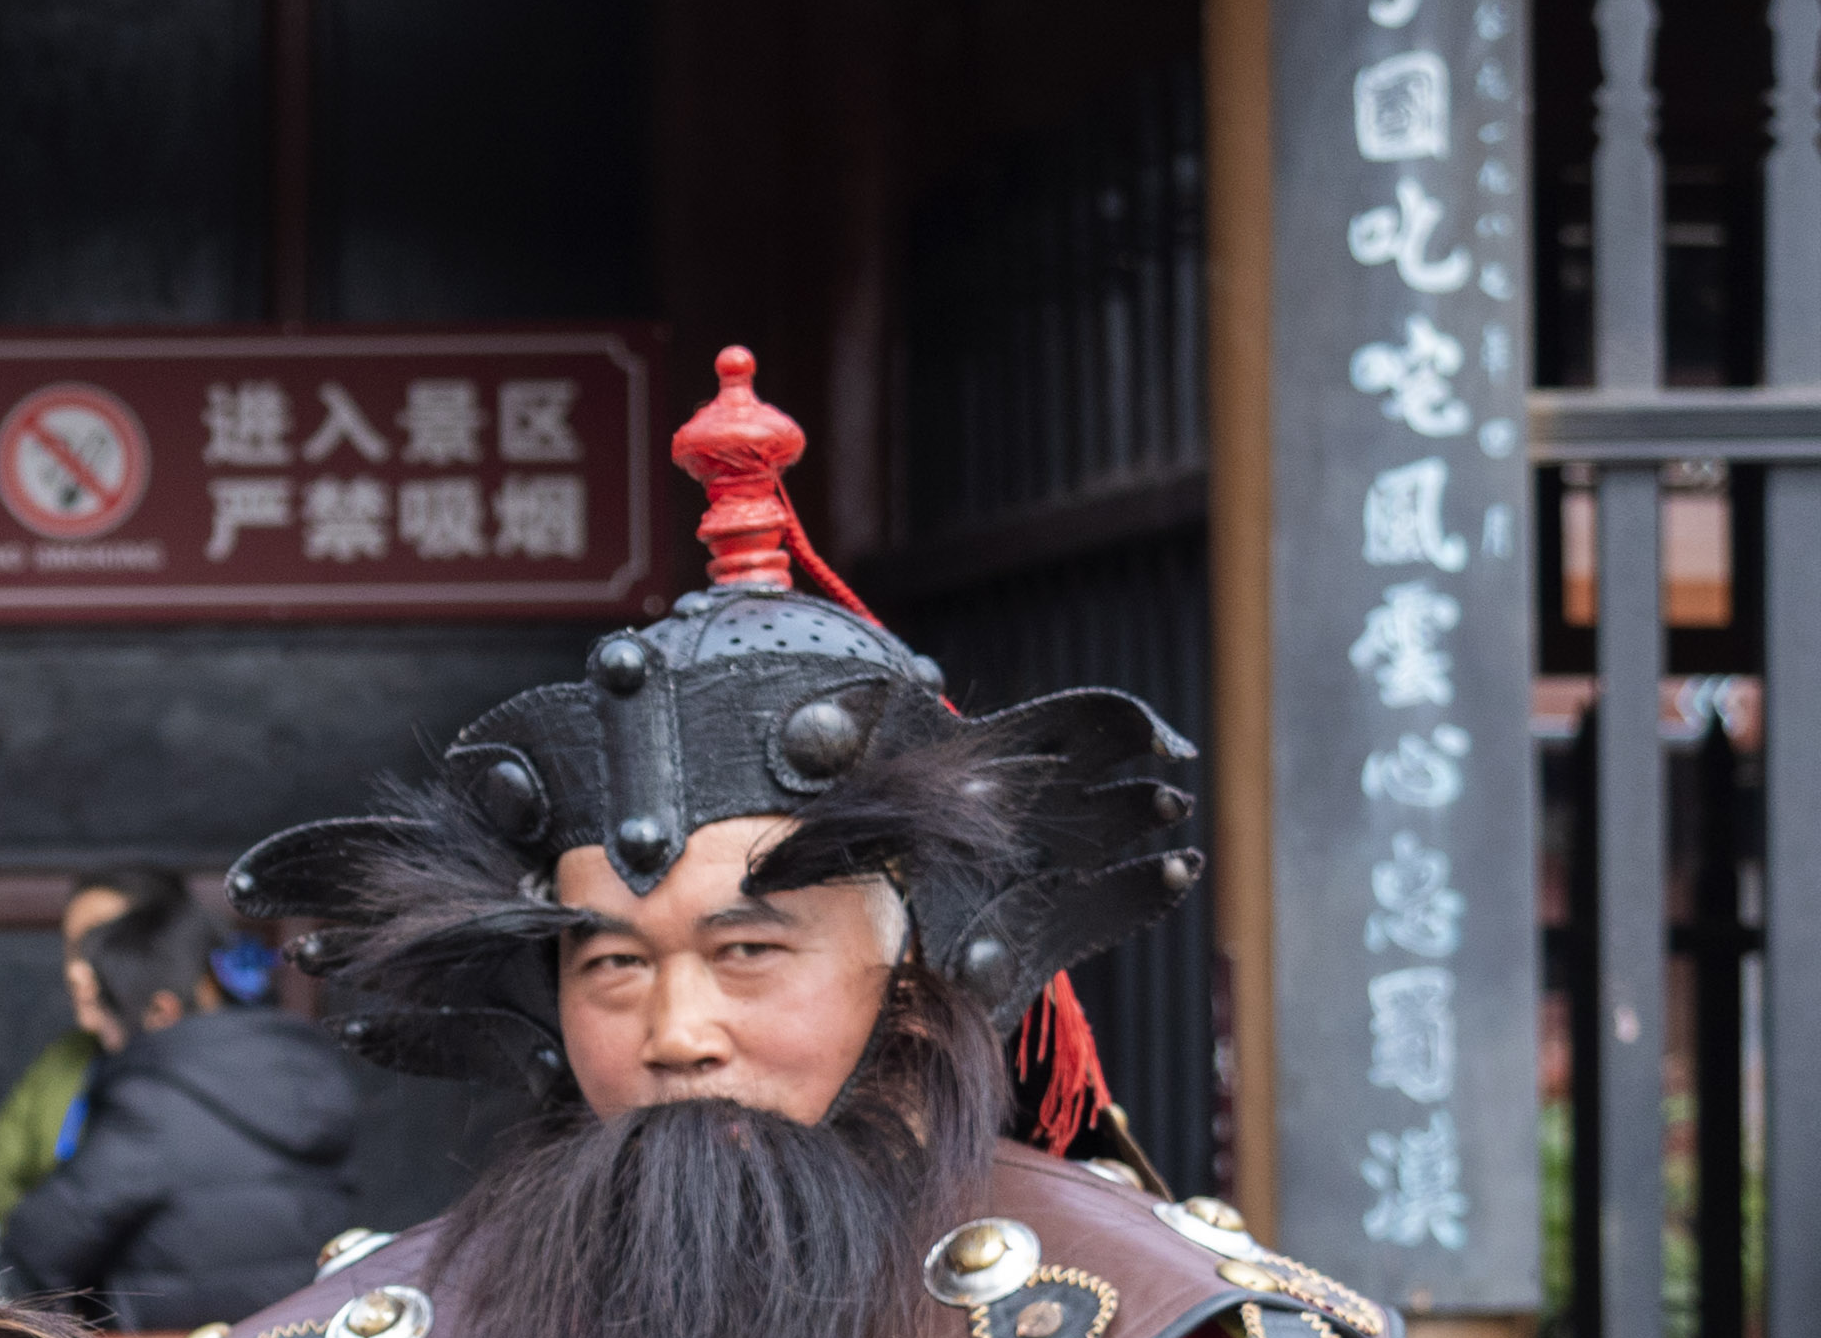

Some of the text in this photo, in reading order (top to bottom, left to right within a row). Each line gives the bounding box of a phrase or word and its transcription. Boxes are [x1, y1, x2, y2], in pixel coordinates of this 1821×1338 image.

[202, 380, 580, 464] 进入景区
[205, 476, 587, 561] 严禁吸烟
